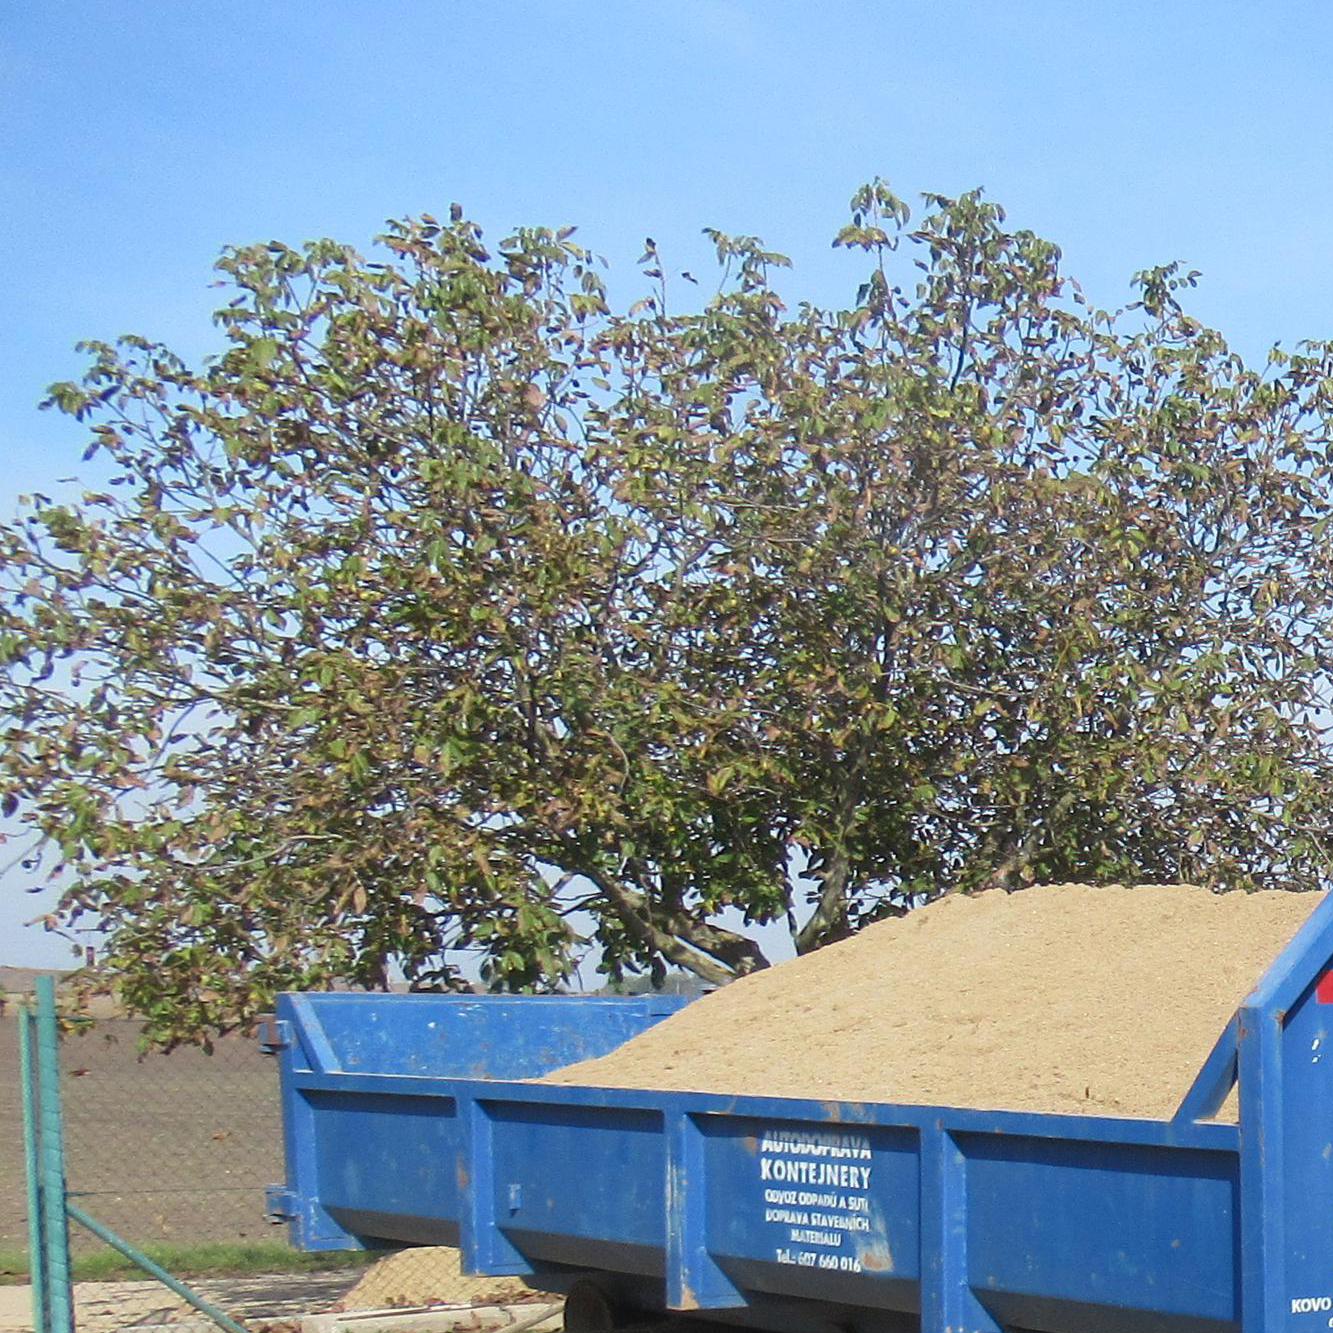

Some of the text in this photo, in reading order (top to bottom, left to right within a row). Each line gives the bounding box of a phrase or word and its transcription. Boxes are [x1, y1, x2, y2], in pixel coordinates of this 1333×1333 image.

[761, 1130, 872, 1160] AUTODOPRAVA
[760, 1157, 871, 1189] KONTEJNERY
[838, 1196, 847, 1209] A
[840, 1256, 861, 1273] 016
[1291, 1298, 1332, 1313] KOVO
